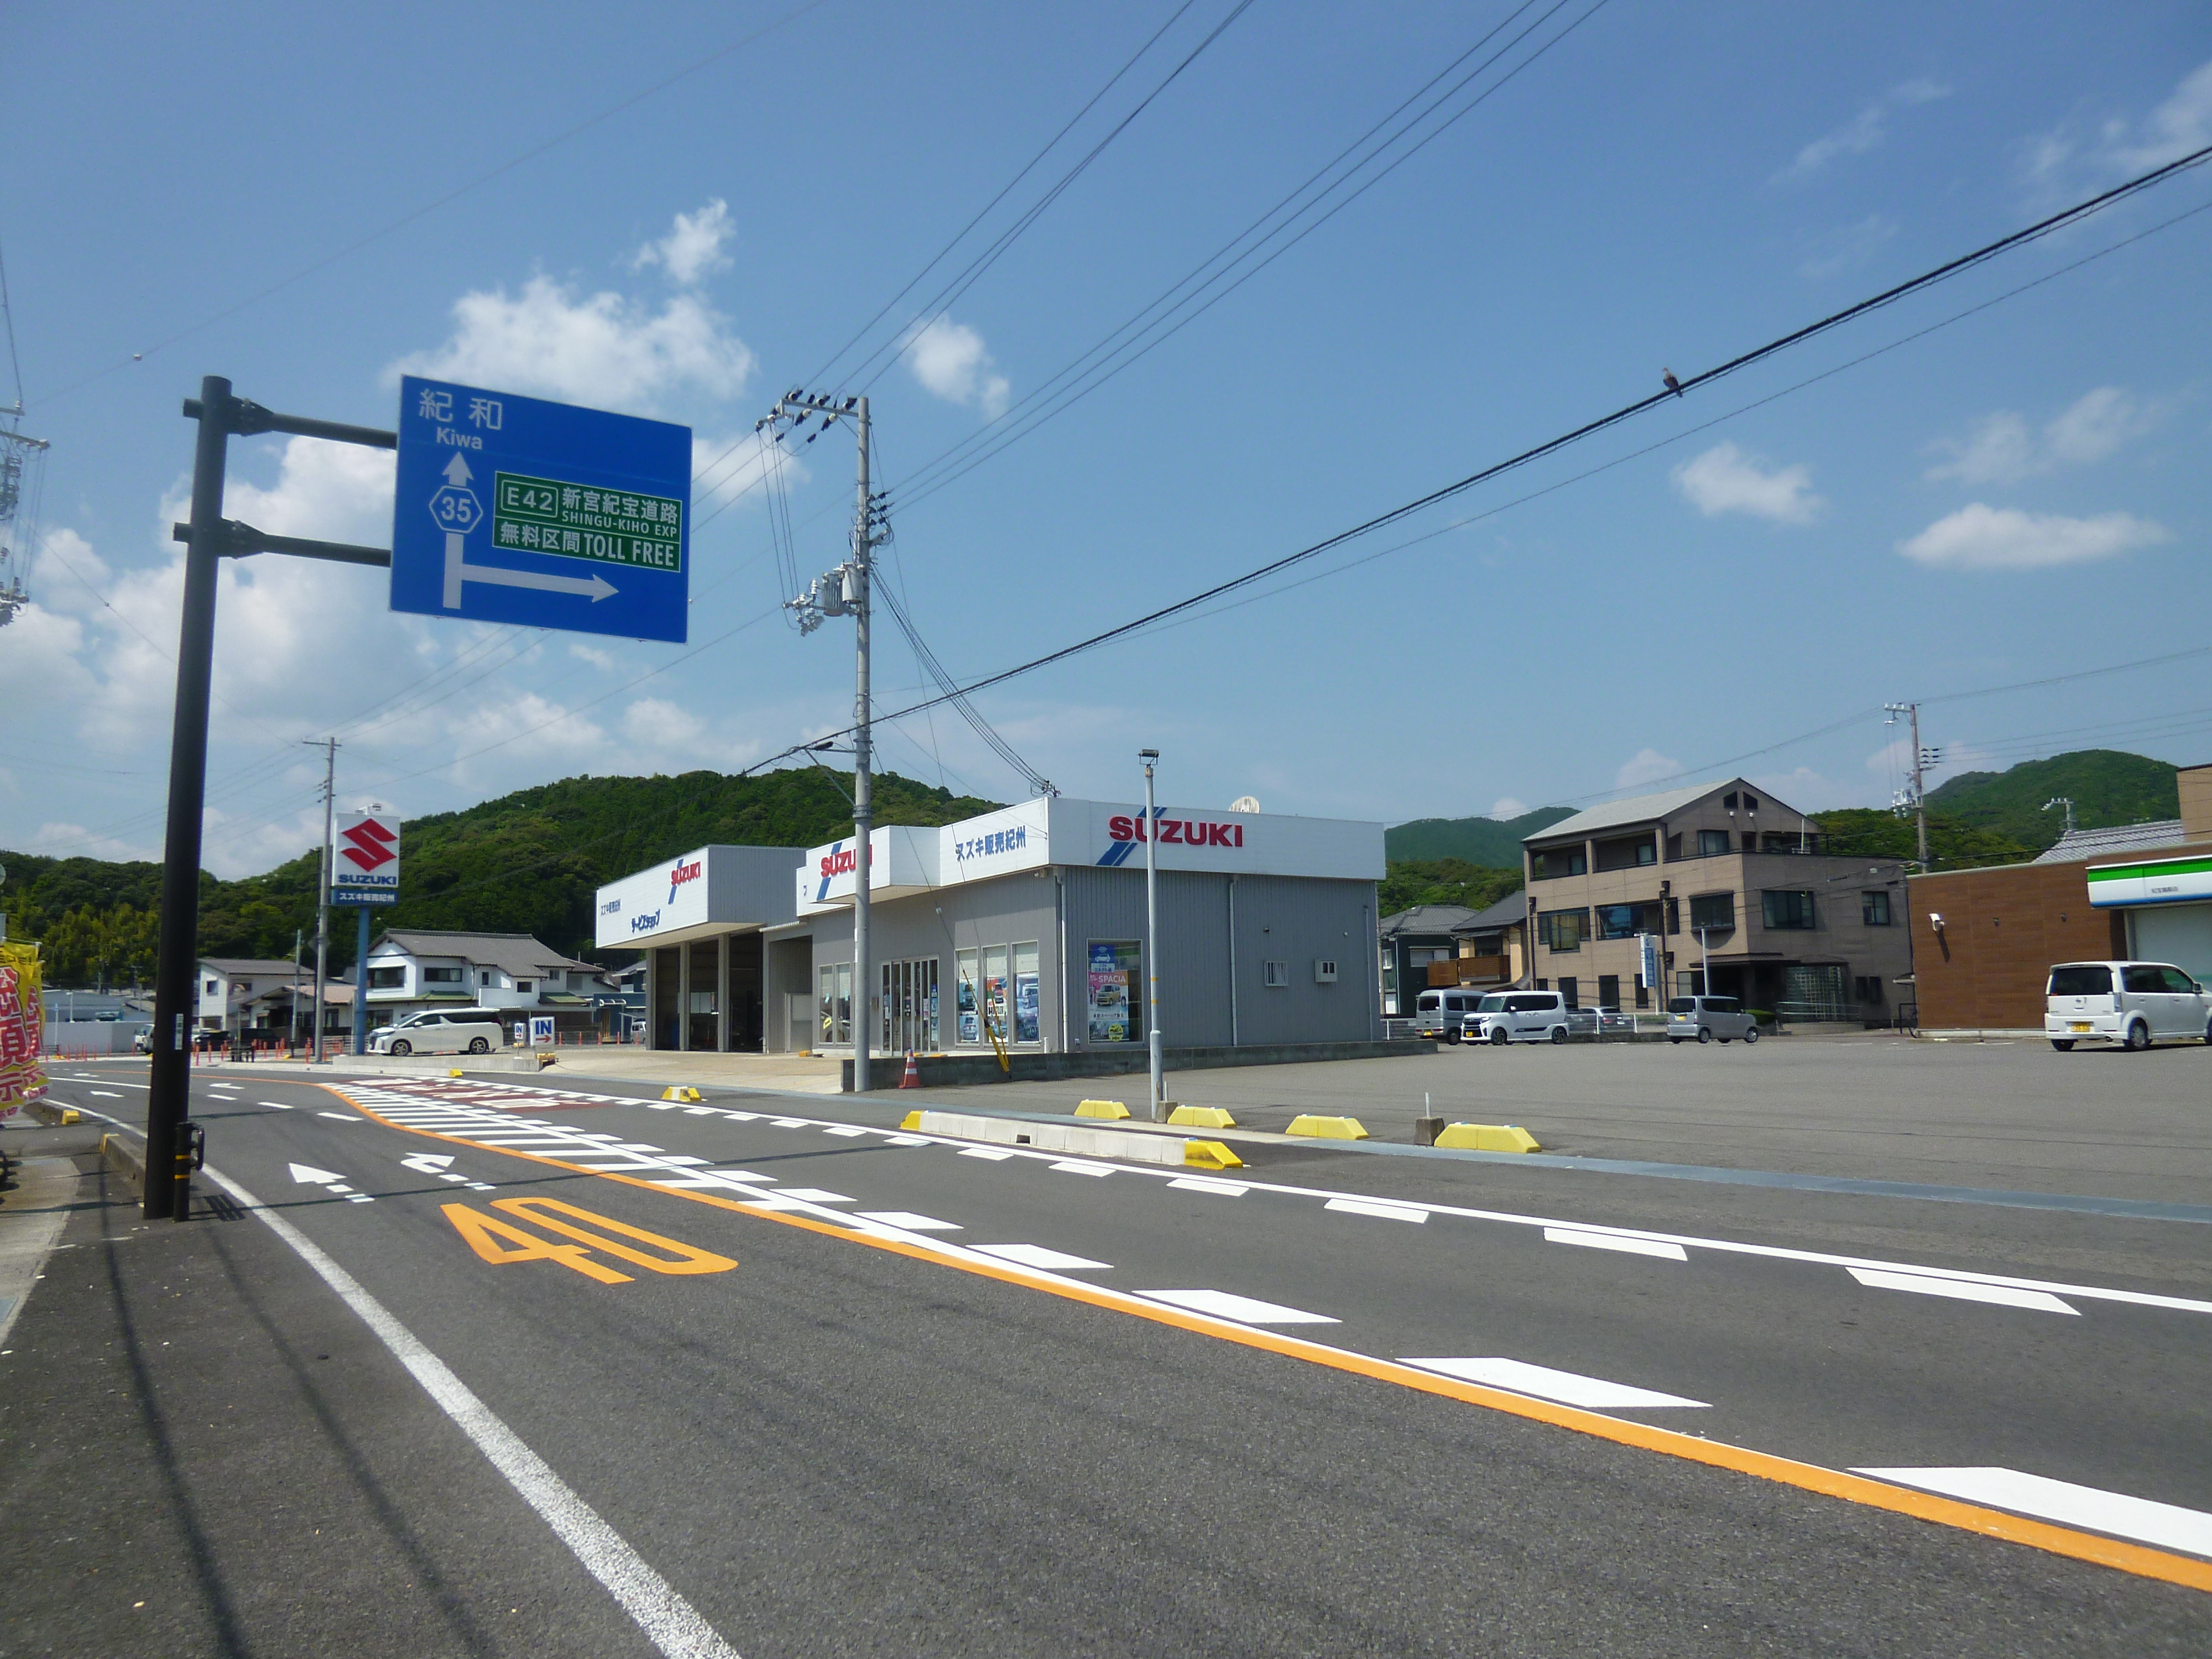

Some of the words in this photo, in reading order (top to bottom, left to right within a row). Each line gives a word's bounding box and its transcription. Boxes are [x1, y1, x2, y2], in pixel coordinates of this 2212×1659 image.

[419, 388, 503, 431] 紀和
[436, 426, 483, 450] Kiwa
[442, 496, 471, 523] 35
[507, 487, 554, 512] E42
[562, 487, 678, 525] 新宮紀宝道路
[562, 510, 649, 534] SHINGU-KIHO
[655, 525, 678, 538] EXP
[500, 521, 581, 553] 無料区間
[584, 533, 625, 561] TOLL
[633, 540, 674, 567] FREE
[956, 825, 1026, 862] スズキ販売紀州
[1109, 816, 1243, 847] SUZUKI
[671, 861, 701, 886] SUZUKI
[821, 844, 873, 878] SUZUI
[338, 874, 397, 885] SUZUKI
[535, 1020, 552, 1035] IN
[440, 1197, 739, 1284] 40
